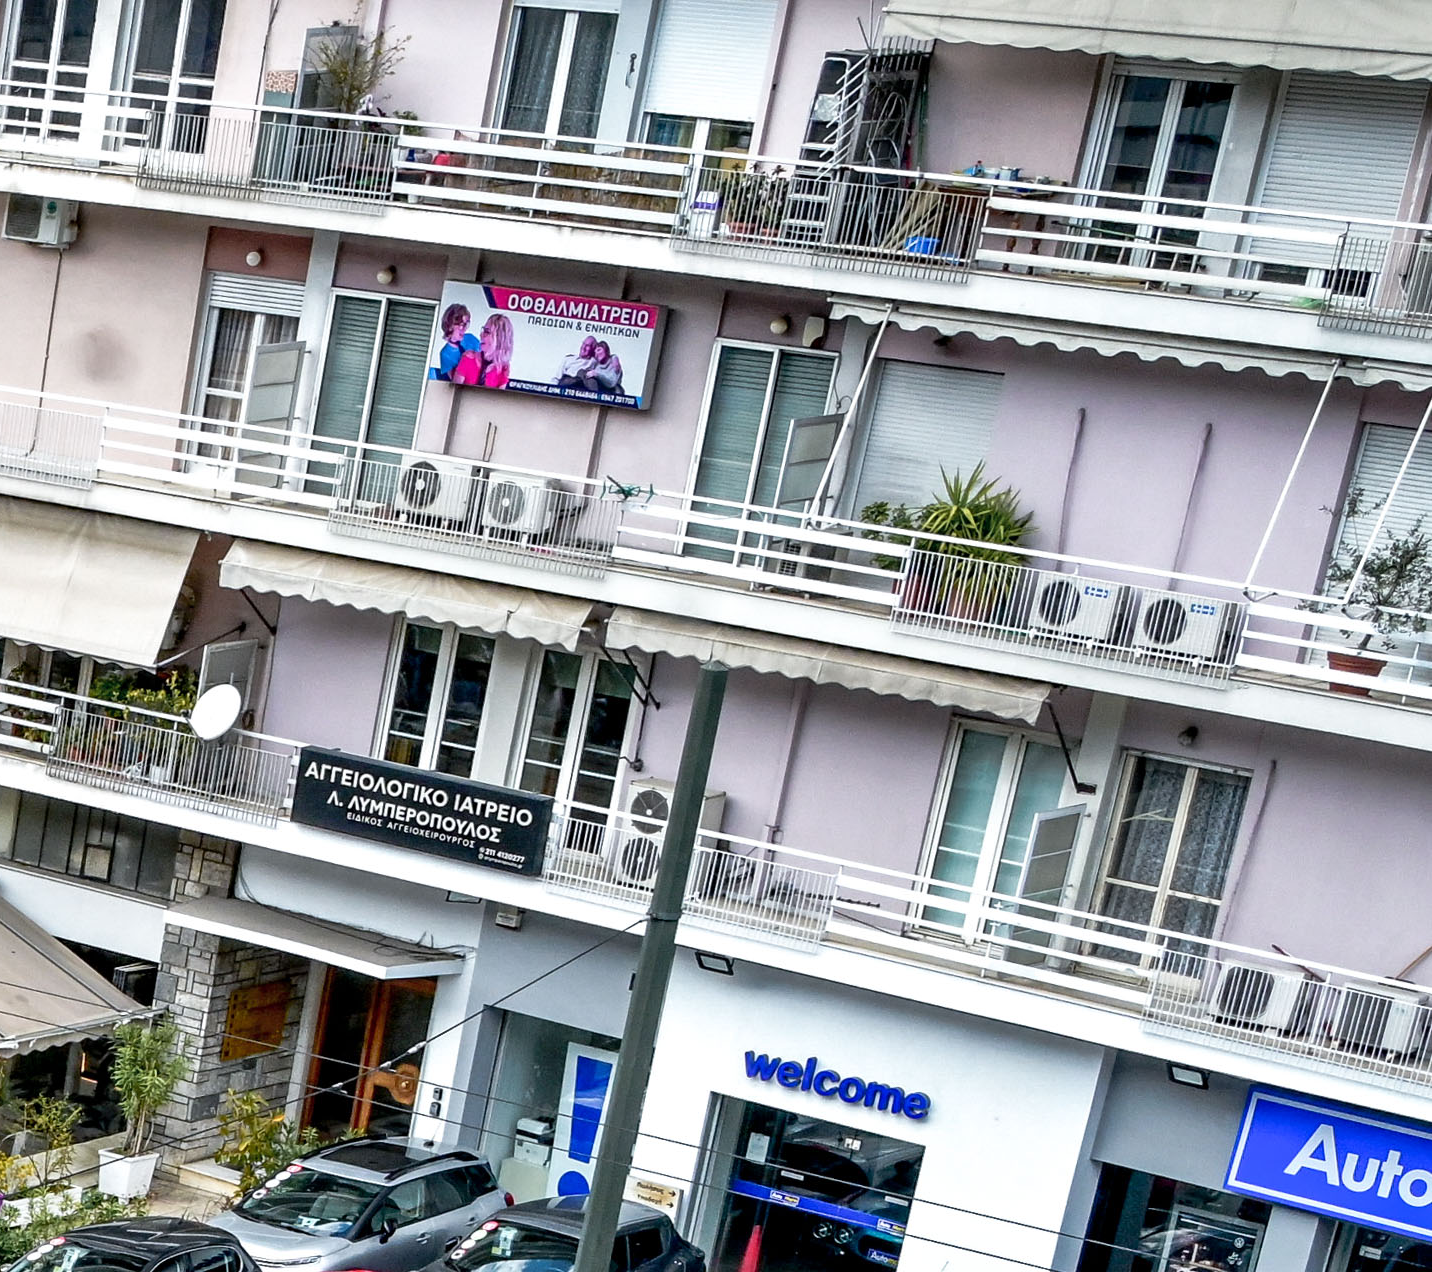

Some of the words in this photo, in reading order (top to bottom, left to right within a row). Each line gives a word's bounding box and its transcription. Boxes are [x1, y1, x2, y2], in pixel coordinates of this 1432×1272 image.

[508, 293, 649, 327] ΟΦΘΑΛΜΙΑΤΡΕΙΟ
[304, 761, 449, 808] ΑΓΓΕΙΟΛΟΓΙΚΟ
[454, 793, 533, 827] ΙΑΤΡΕΙΟ
[347, 796, 502, 843] ΛΥΜΠΕΡΟΠΟΥΛΟΣ
[346, 811, 383, 828] ΕΙΔΙΚΟΣ
[386, 821, 475, 849] ΑΓΓΕΙΟΧΕΙΡΟΥΡΓΟΣ
[744, 1050, 931, 1120] welcome
[1283, 1123, 1432, 1208] Auto
